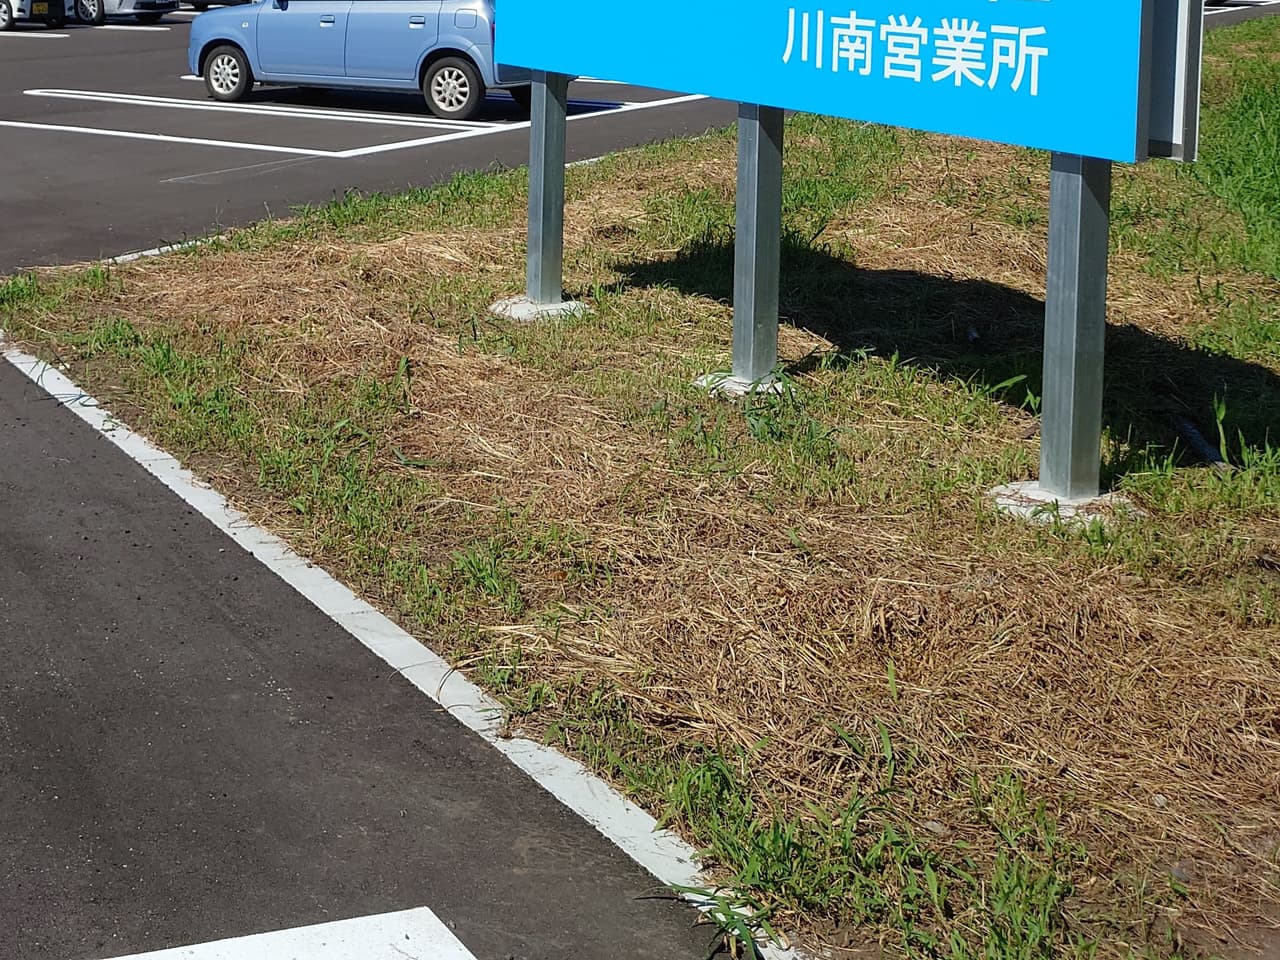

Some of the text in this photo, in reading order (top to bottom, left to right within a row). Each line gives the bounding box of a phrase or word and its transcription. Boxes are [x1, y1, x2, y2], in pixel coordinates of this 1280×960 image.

[782, 8, 1049, 96] 川南営業所
